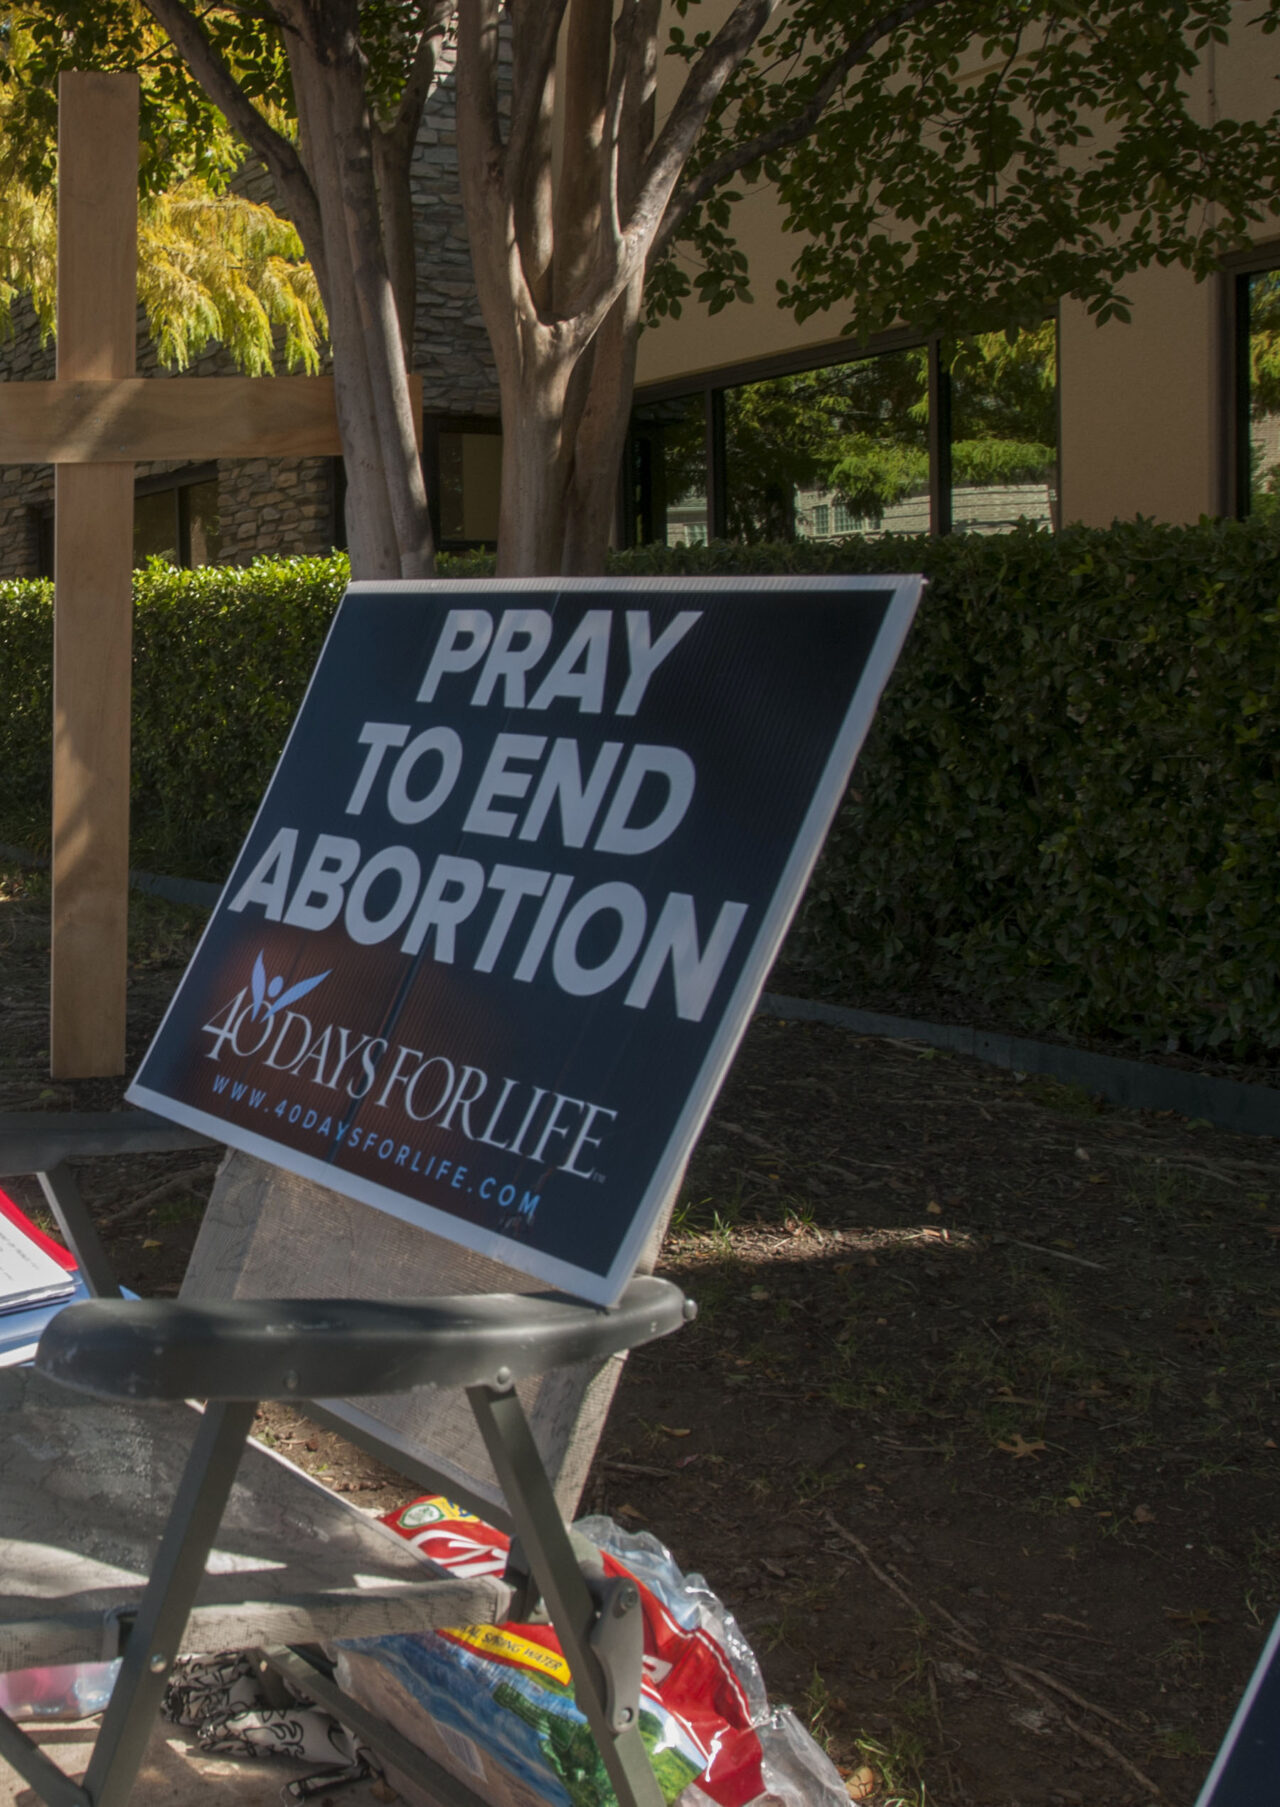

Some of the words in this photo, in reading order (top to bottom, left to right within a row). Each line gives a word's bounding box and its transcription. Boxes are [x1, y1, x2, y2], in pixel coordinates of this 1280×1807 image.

[416, 609, 704, 716] PRAY
[345, 722, 463, 825] TO
[462, 733, 696, 856] END
[229, 827, 749, 1022] ABORTION
[201, 986, 275, 1061] 40
[263, 1011, 388, 1099] DAYS
[375, 1046, 477, 1141] FOR
[475, 1077, 619, 1179] LIFE
[212, 1074, 541, 1220] WWW.40DAYSFORLIFE.COM
[482, 1632, 522, 1653] SPRING
[523, 1647, 563, 1671] WATER
